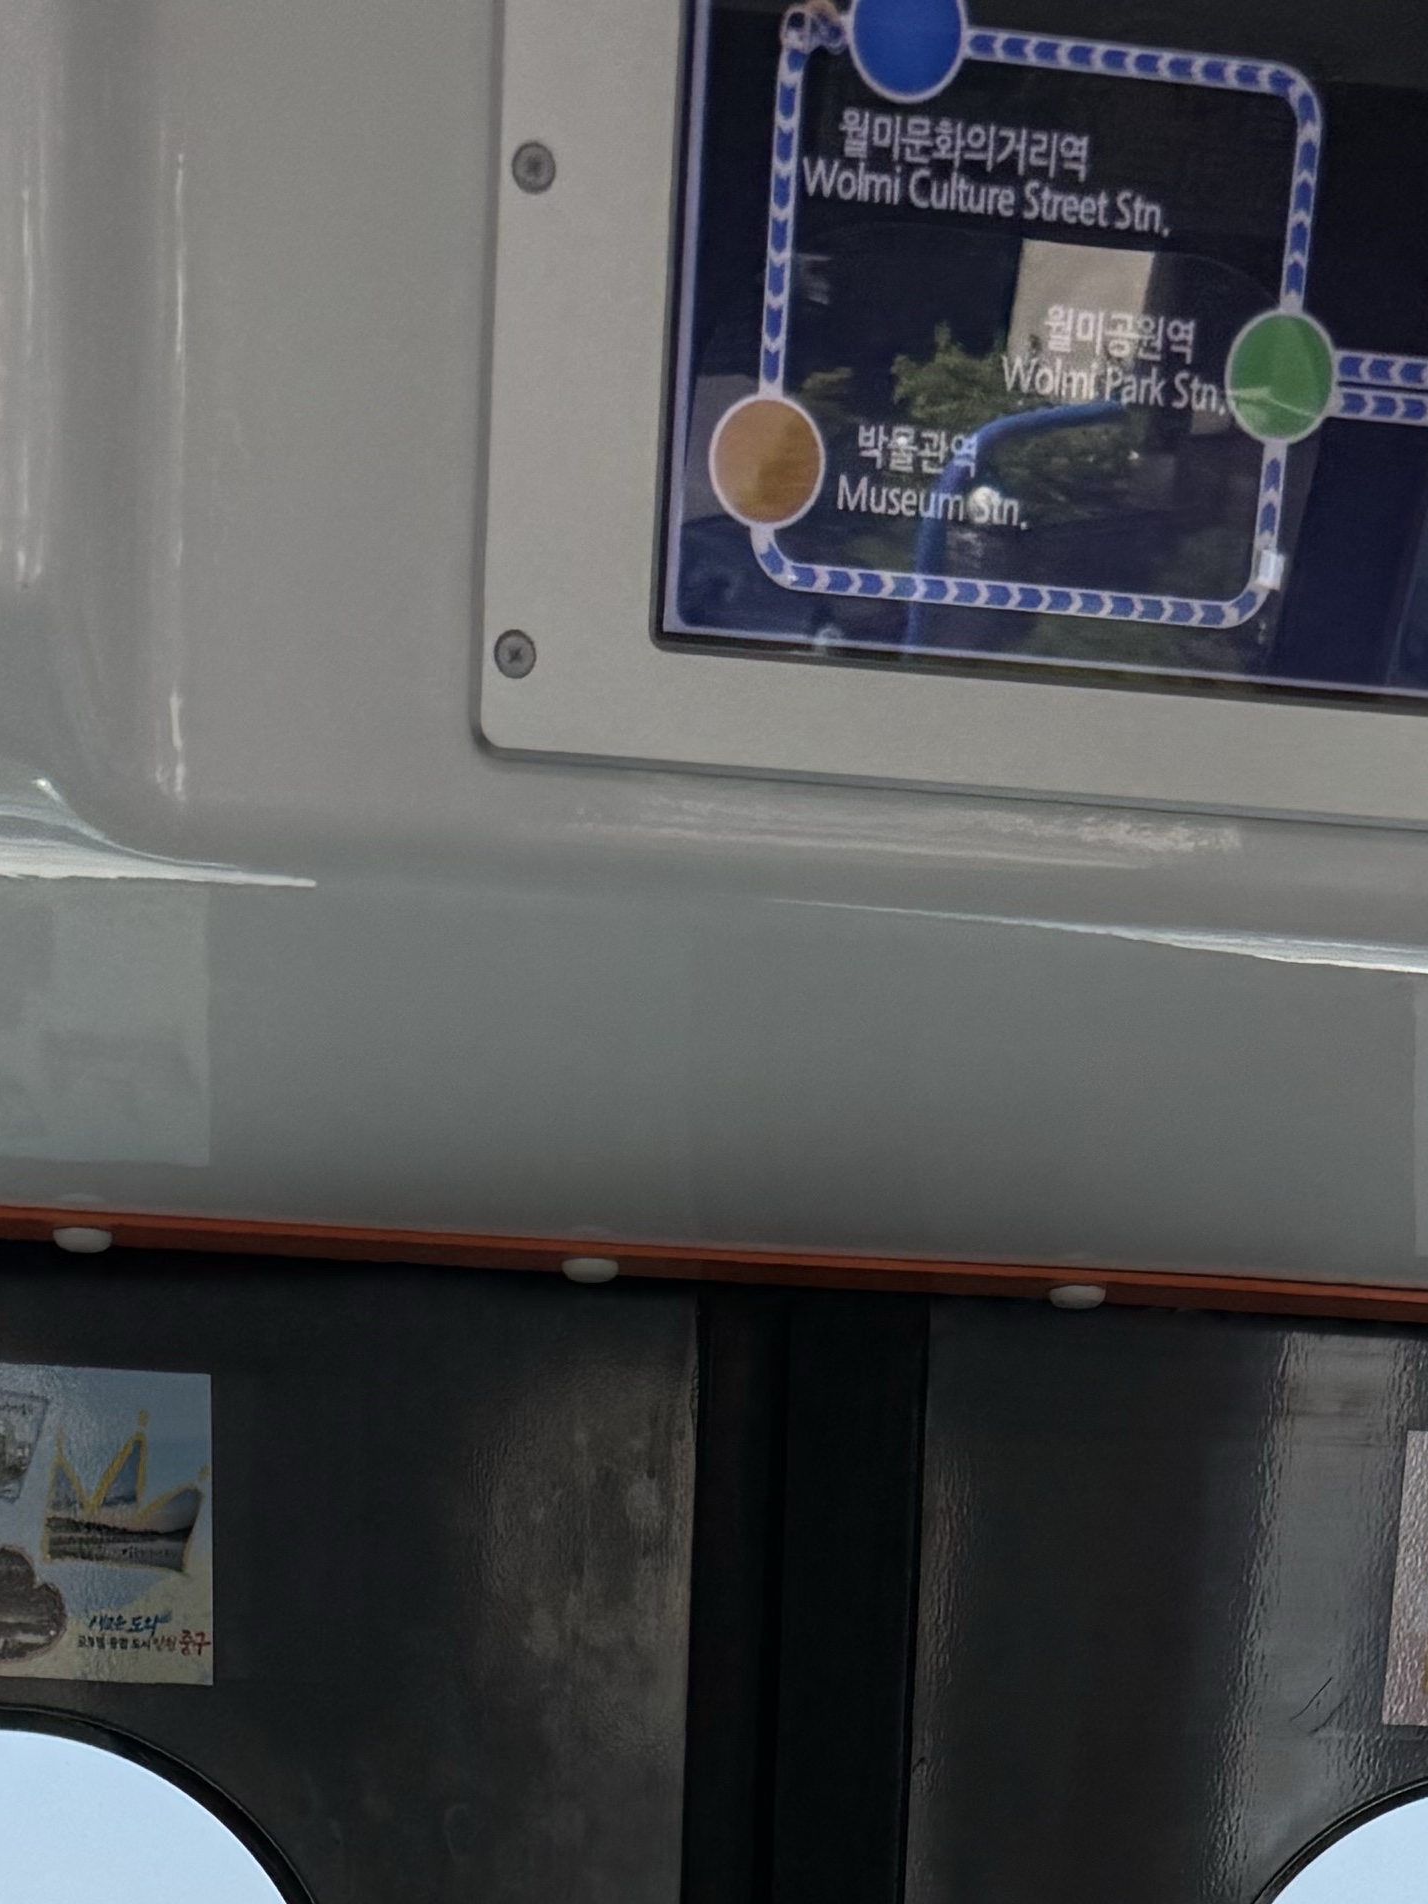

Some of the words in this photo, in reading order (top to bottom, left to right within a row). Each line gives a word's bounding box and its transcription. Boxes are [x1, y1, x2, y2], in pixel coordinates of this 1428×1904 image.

[838, 106, 1089, 182] 월미문화의거리역
[802, 156, 901, 205] Wolmi
[909, 166, 1015, 217] Culture
[1022, 180, 1108, 226] Street
[1119, 189, 1170, 237] Stn.
[1042, 303, 1197, 364] 월미공원역
[1002, 355, 1100, 401] Wolmi
[1106, 369, 1166, 407] Park
[1172, 370, 1226, 416] Stn.
[858, 423, 979, 477] 박물관역
[837, 474, 965, 520] Museum
[970, 486, 1029, 531] Stn.
[179, 1629, 211, 1656] 중구
